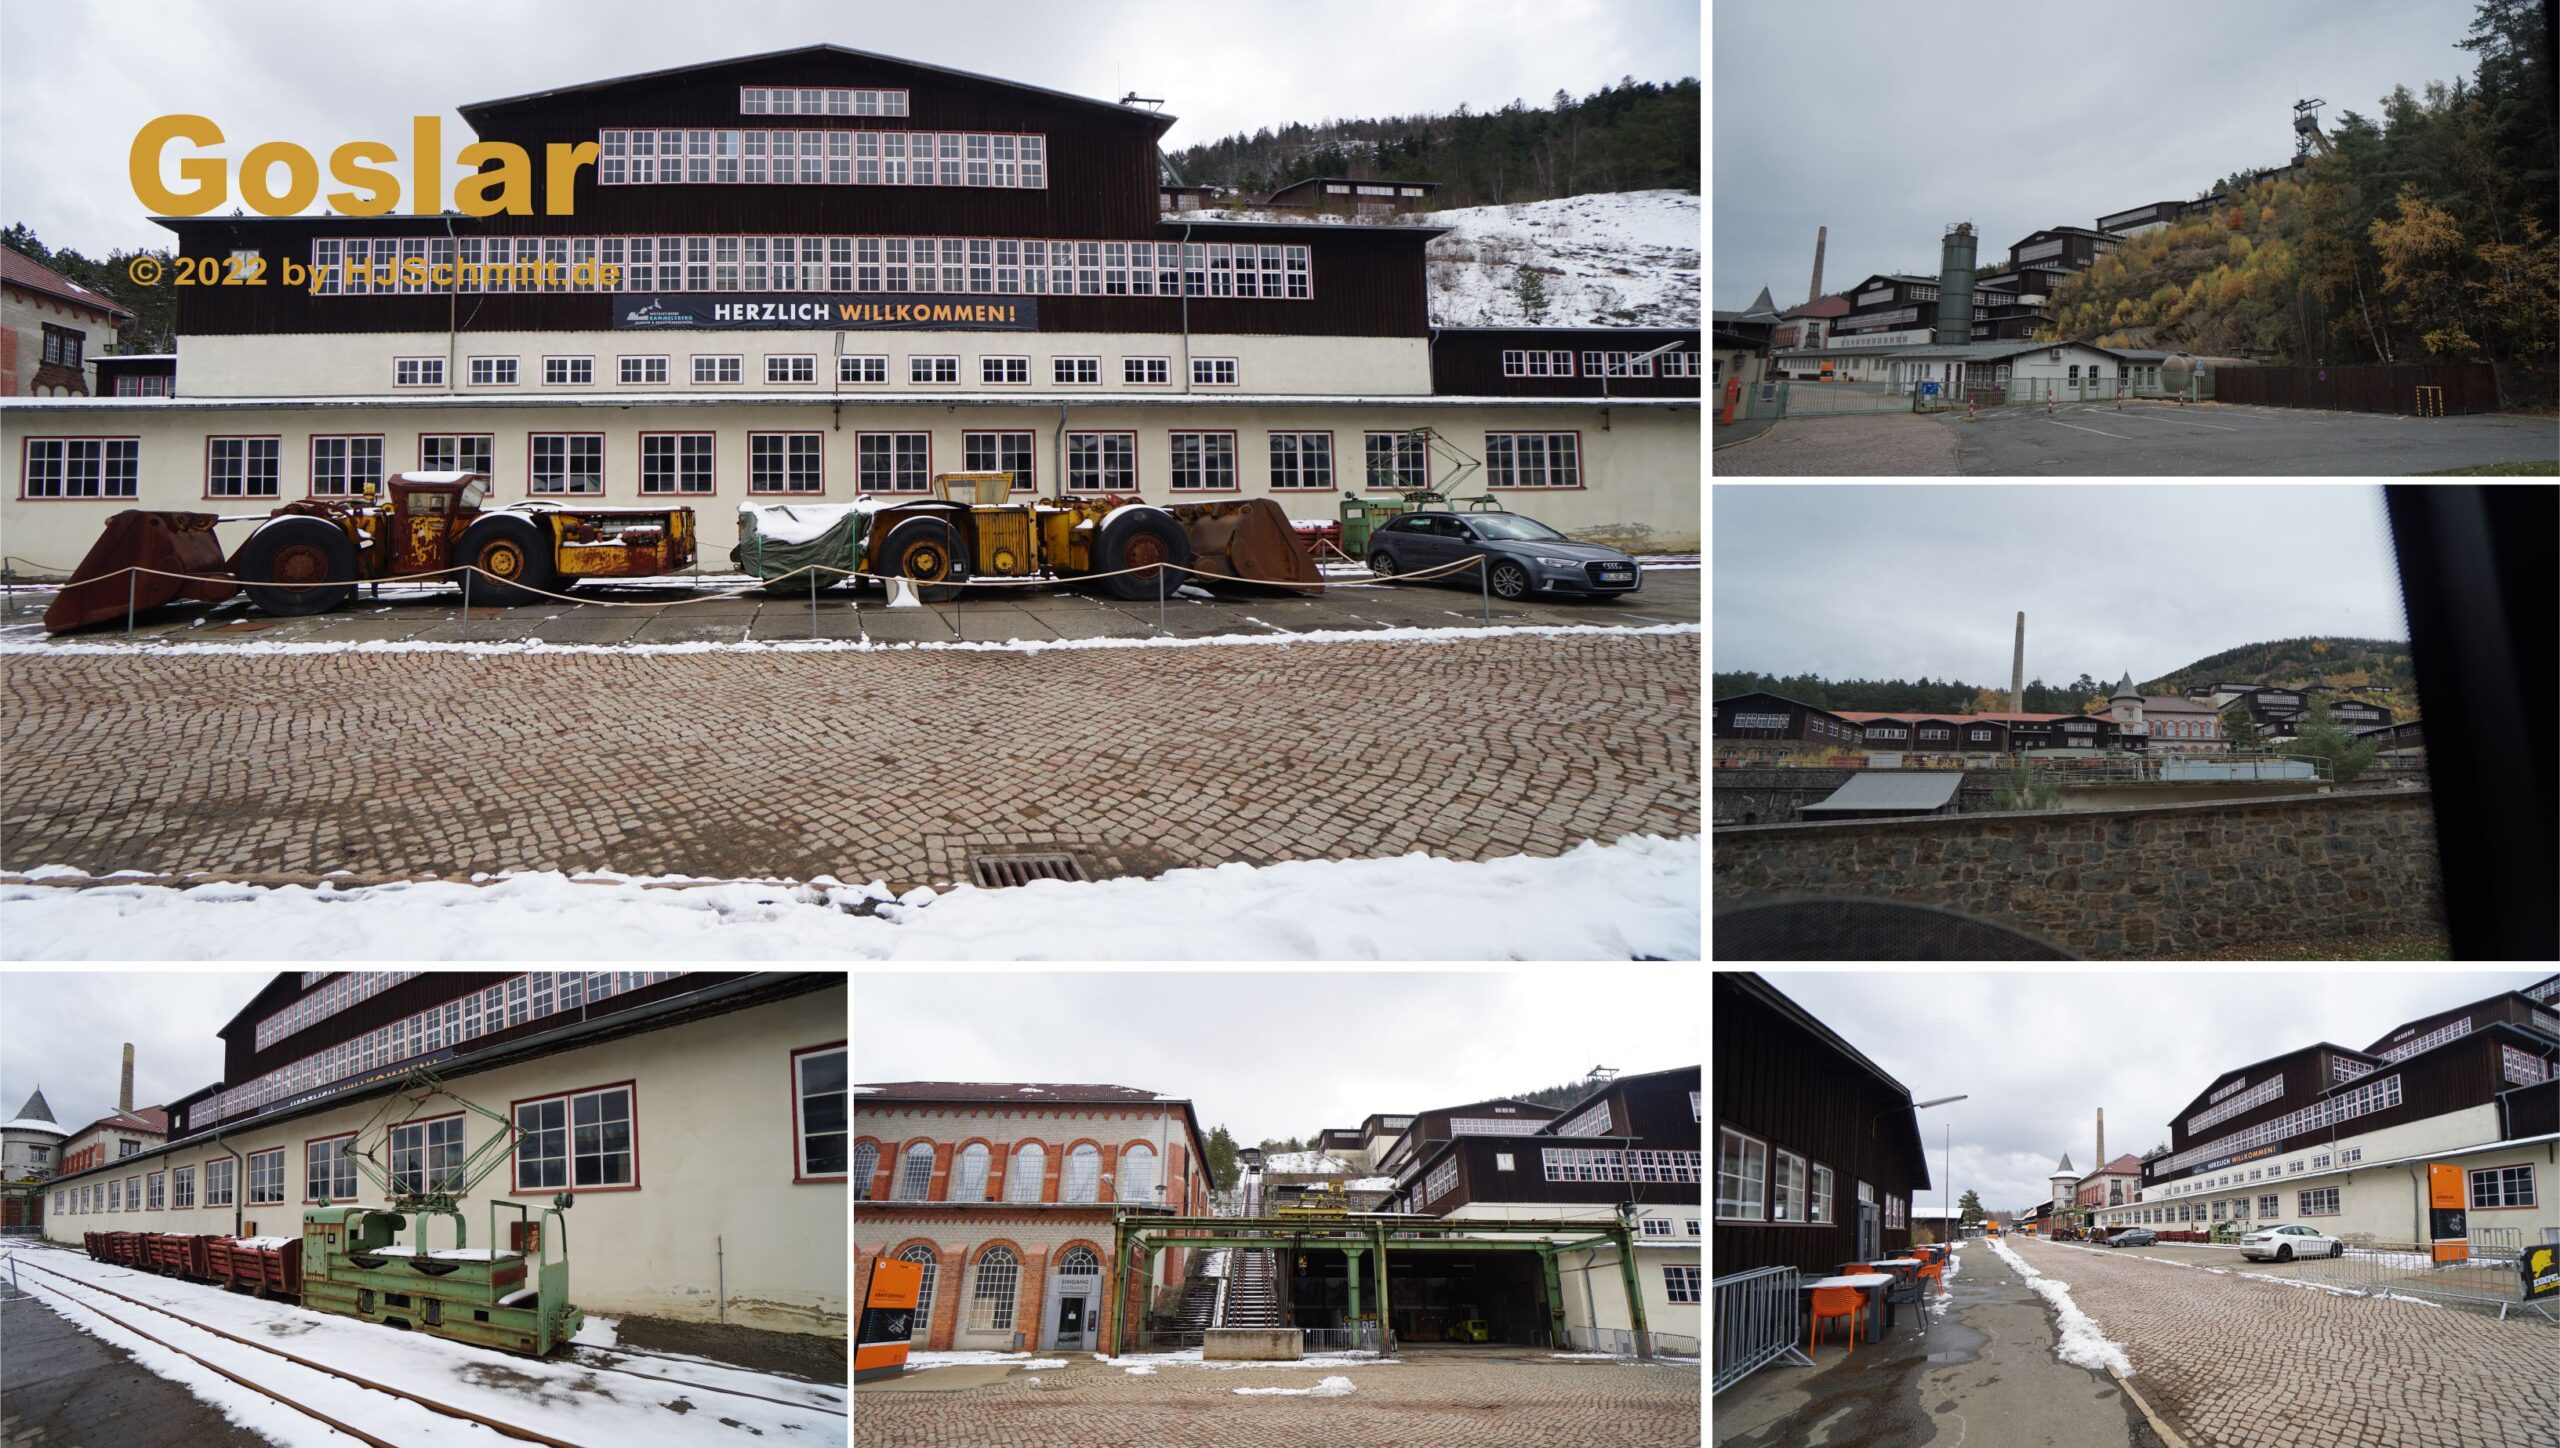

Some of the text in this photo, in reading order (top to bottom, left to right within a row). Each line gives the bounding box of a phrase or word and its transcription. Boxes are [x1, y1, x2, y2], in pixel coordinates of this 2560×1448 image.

[715, 303, 1016, 322] HERZLICH WILLKOMMEN!
[2207, 1145, 2276, 1170] HERZLICH WILLKOMMEN!
